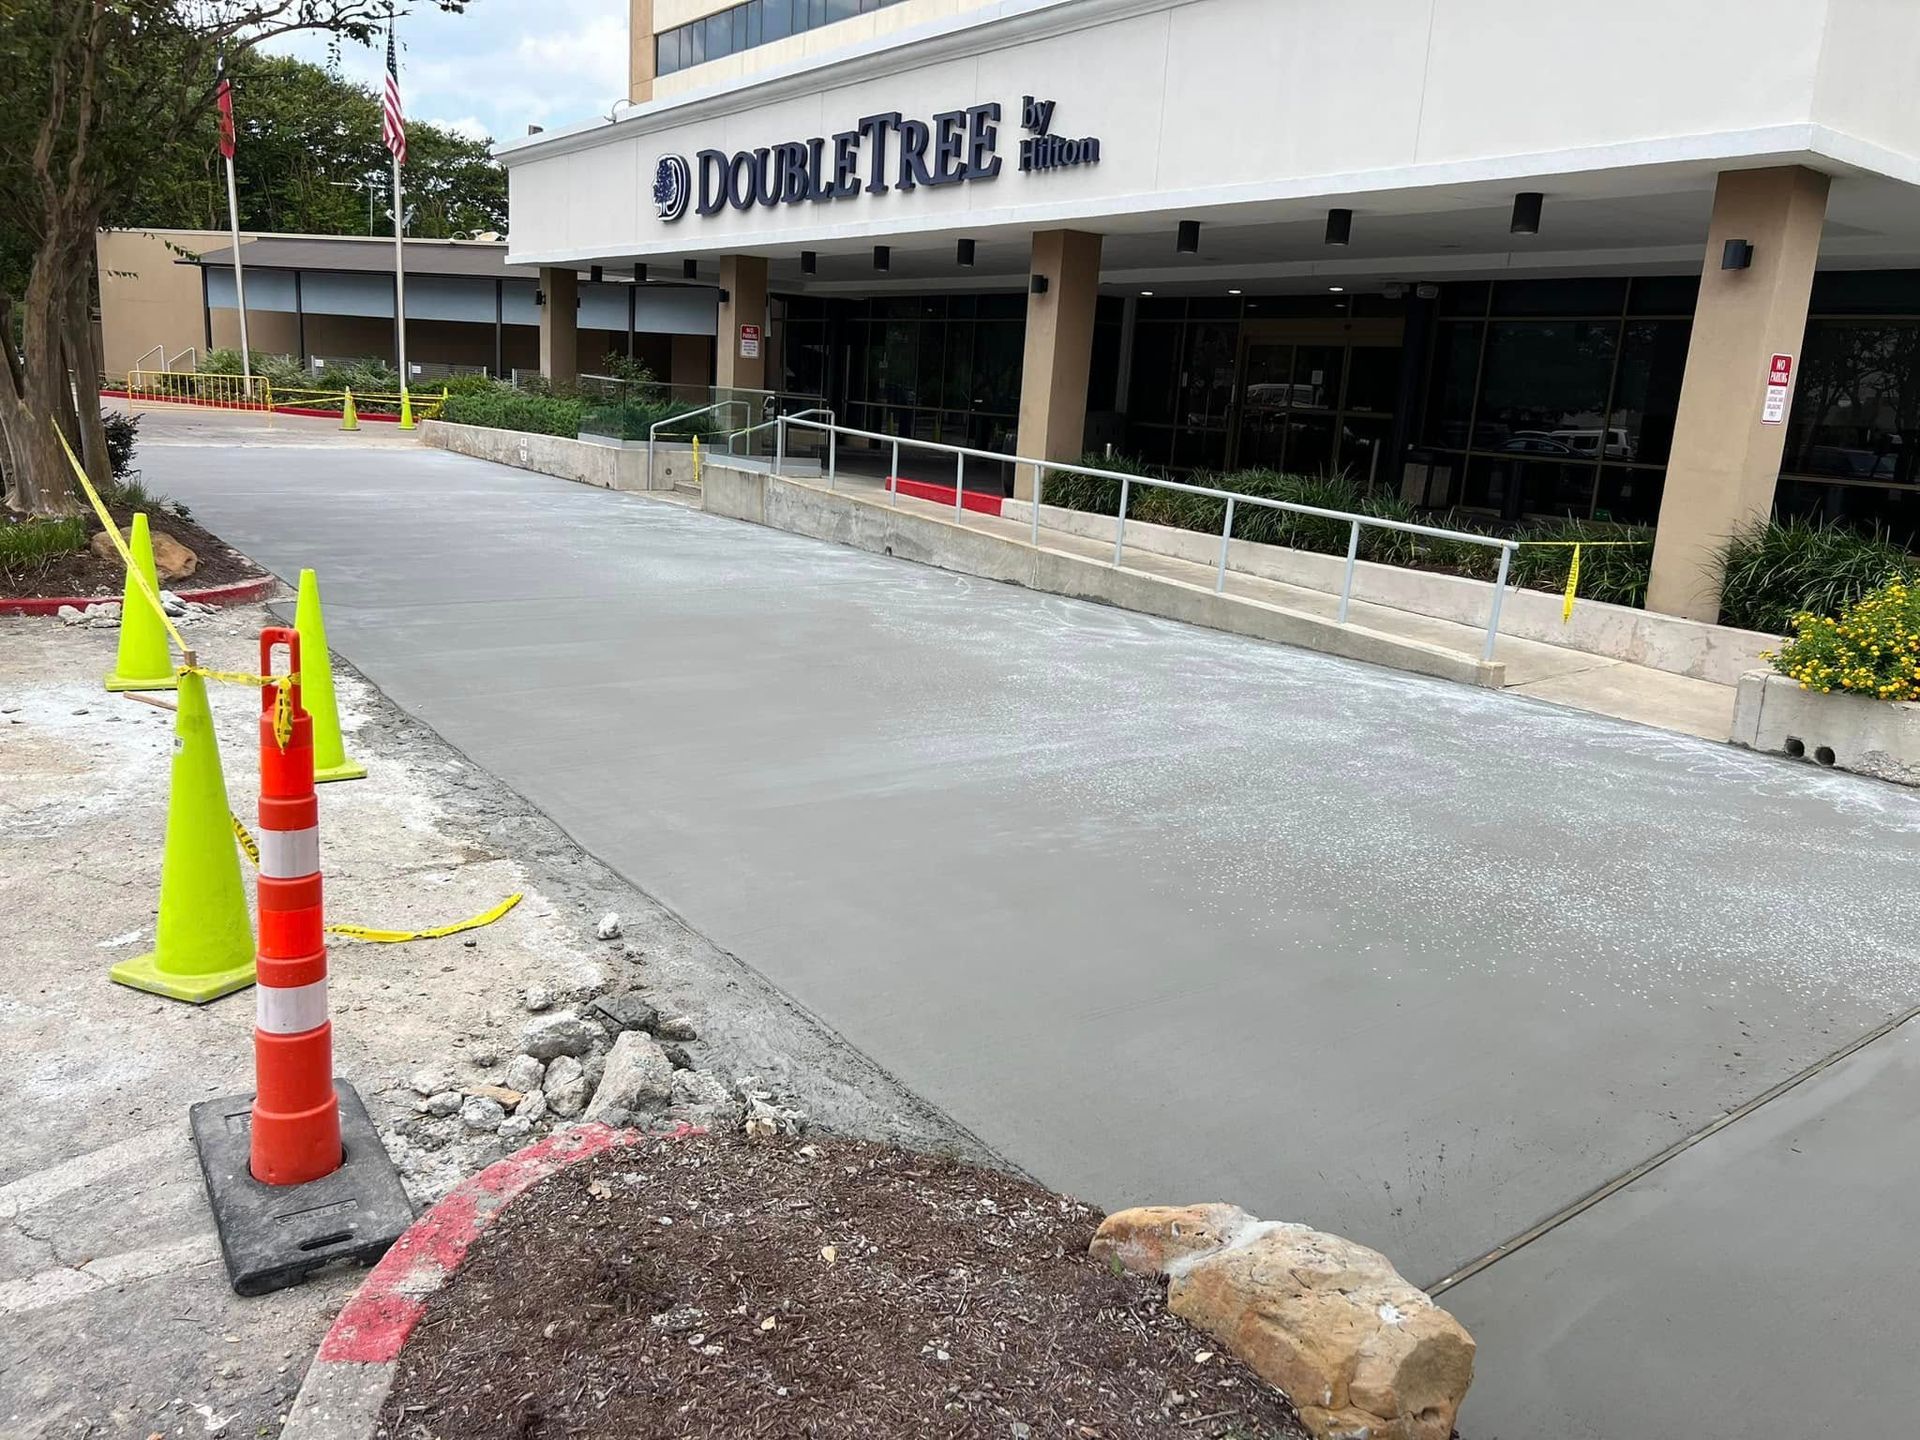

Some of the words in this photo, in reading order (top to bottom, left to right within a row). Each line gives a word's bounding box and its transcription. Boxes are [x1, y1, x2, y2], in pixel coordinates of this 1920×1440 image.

[1021, 95, 1056, 135] by
[1018, 134, 1100, 171] Hilton
[1770, 371, 1788, 383] PARKING
[1776, 360, 1786, 370] NO
